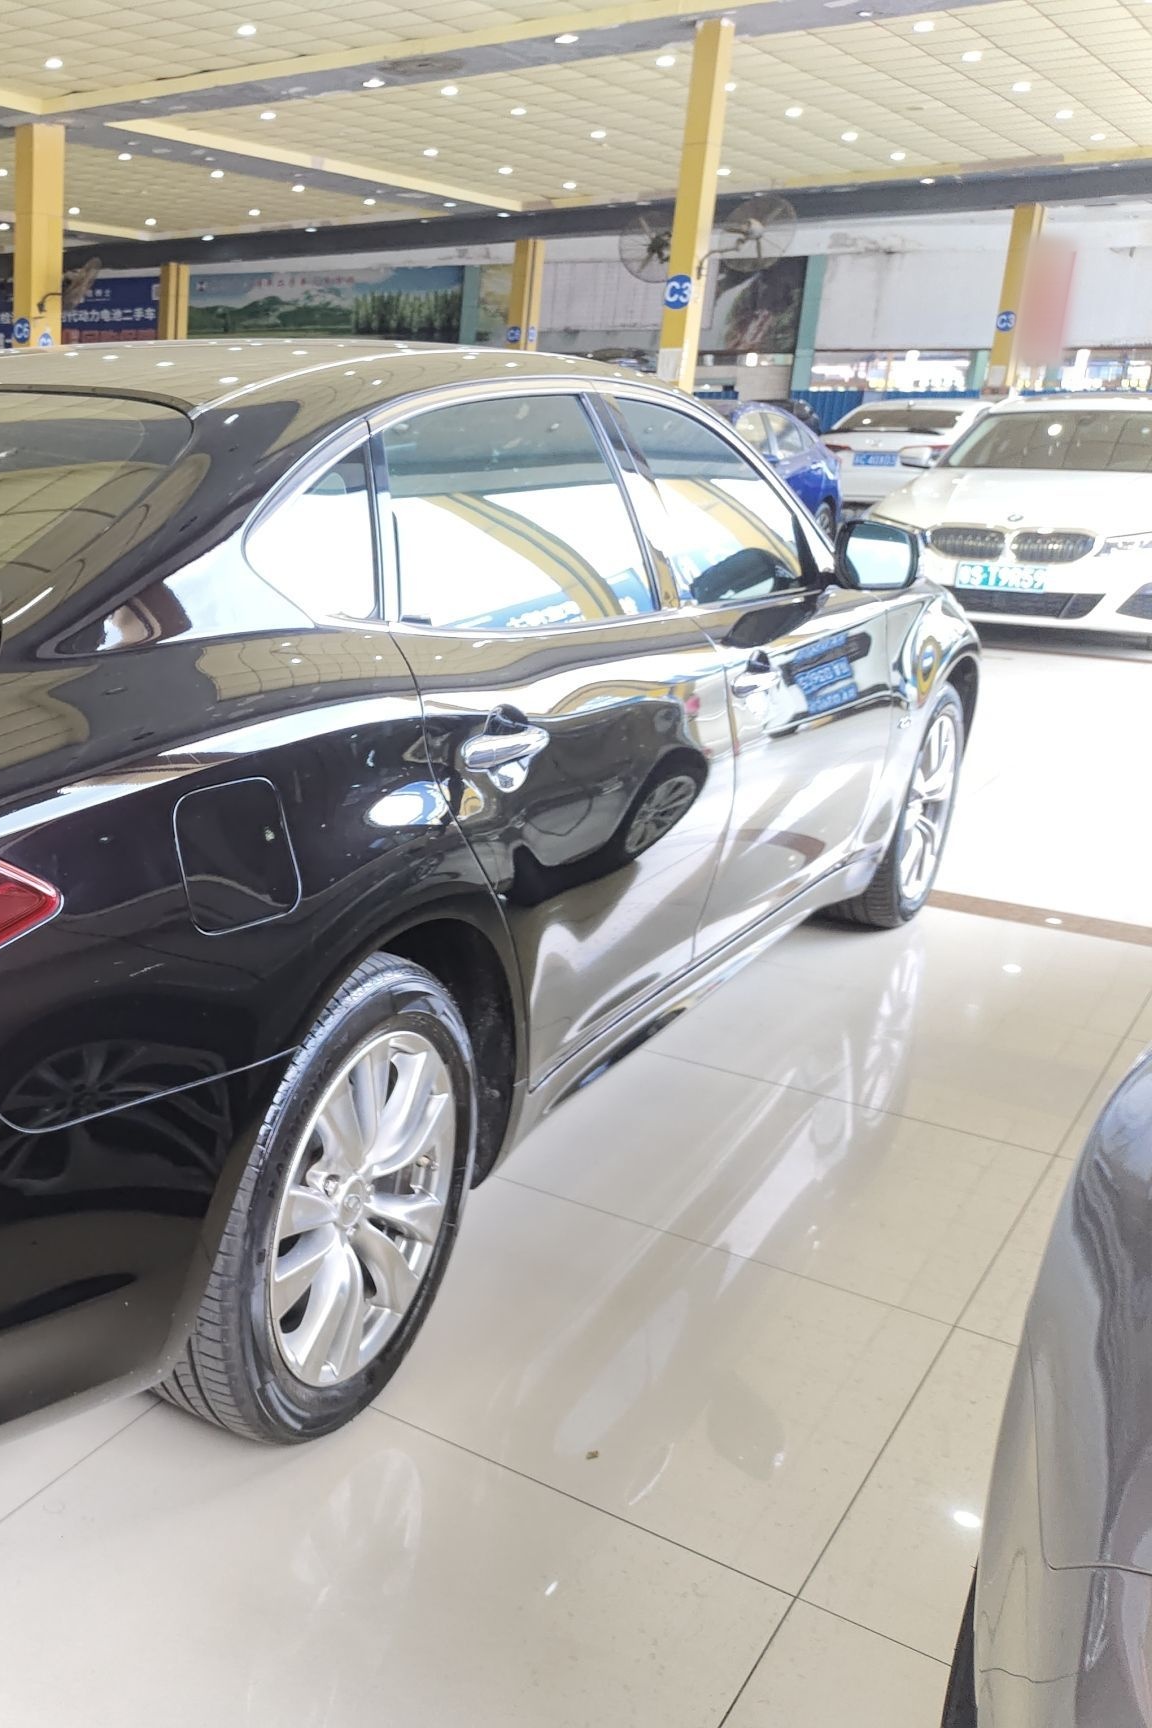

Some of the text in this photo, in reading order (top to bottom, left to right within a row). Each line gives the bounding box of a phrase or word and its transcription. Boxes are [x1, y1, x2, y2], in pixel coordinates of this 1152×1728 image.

[665, 281, 691, 303] C3
[996, 313, 1016, 329] C3
[14, 323, 30, 339] C6
